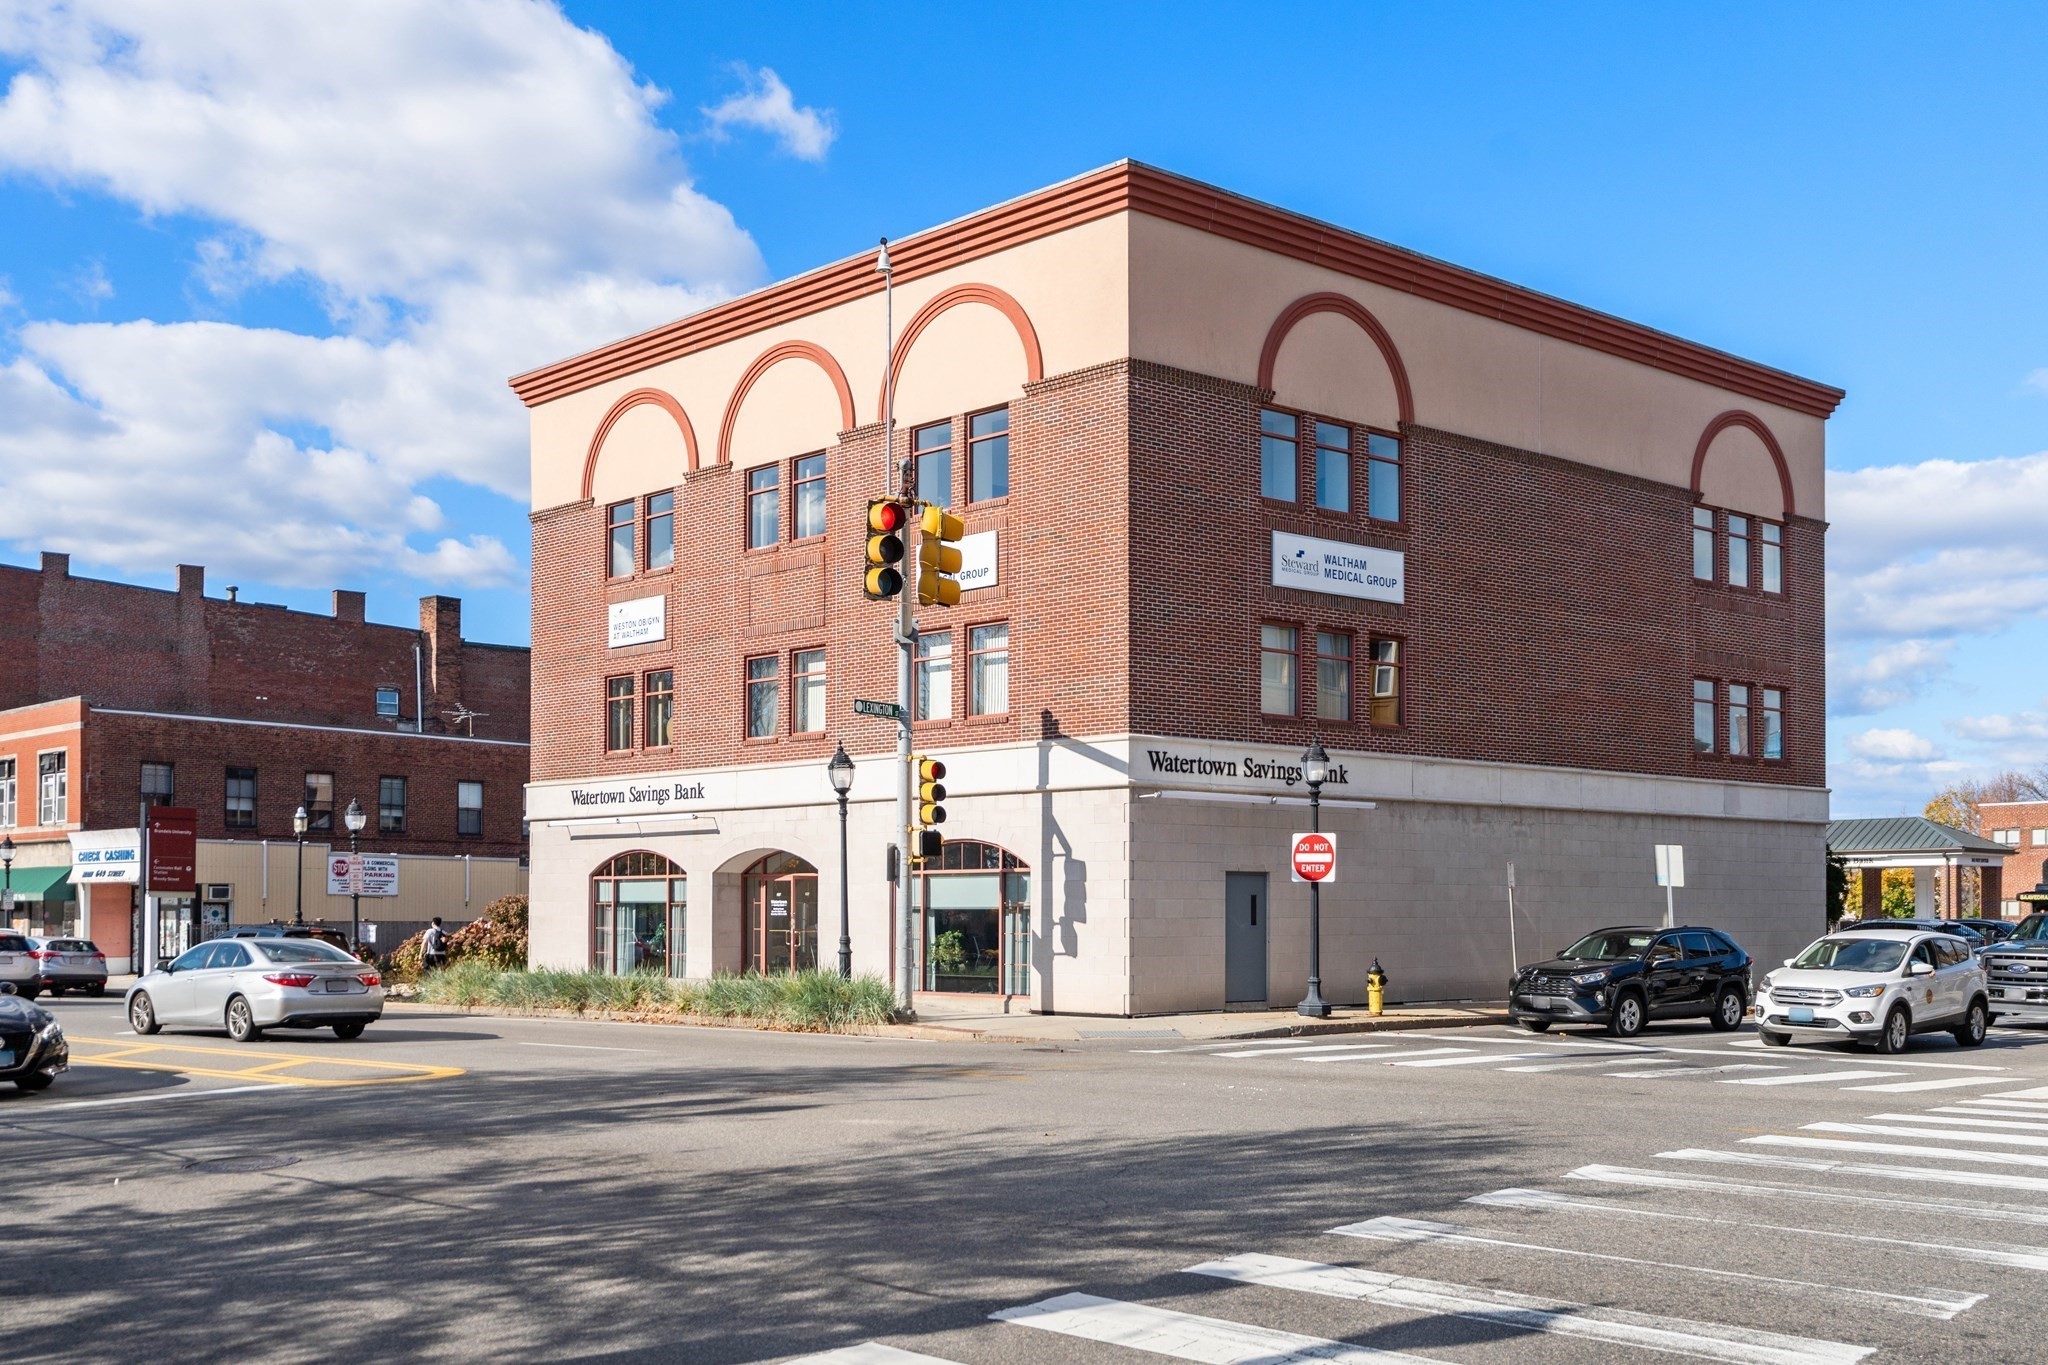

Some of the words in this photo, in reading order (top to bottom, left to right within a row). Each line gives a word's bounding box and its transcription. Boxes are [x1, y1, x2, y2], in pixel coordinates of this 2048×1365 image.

[1281, 554, 1319, 572] Steward
[1324, 553, 1367, 570] WALTHAM
[960, 567, 989, 581] GROUP
[1281, 567, 1302, 575] MEDICAL
[1324, 568, 1364, 583] MEDICAL
[1366, 575, 1398, 588] GROUP
[613, 620, 637, 630] WESTON
[613, 632, 620, 640] AT
[621, 627, 649, 639] WALTHAM
[863, 702, 893, 716] LEXINGTON
[1147, 750, 1237, 777] Watertown
[1243, 757, 1302, 786] Savings
[571, 790, 625, 806] Watertown
[629, 785, 670, 806] Savings
[674, 782, 705, 800] Bank
[1299, 843, 1310, 852] DO
[1314, 843, 1329, 852] NOT
[78, 851, 101, 863] CHECK
[104, 849, 135, 862] CASHING
[333, 863, 349, 874] STOP
[1301, 864, 1326, 873] ENTER
